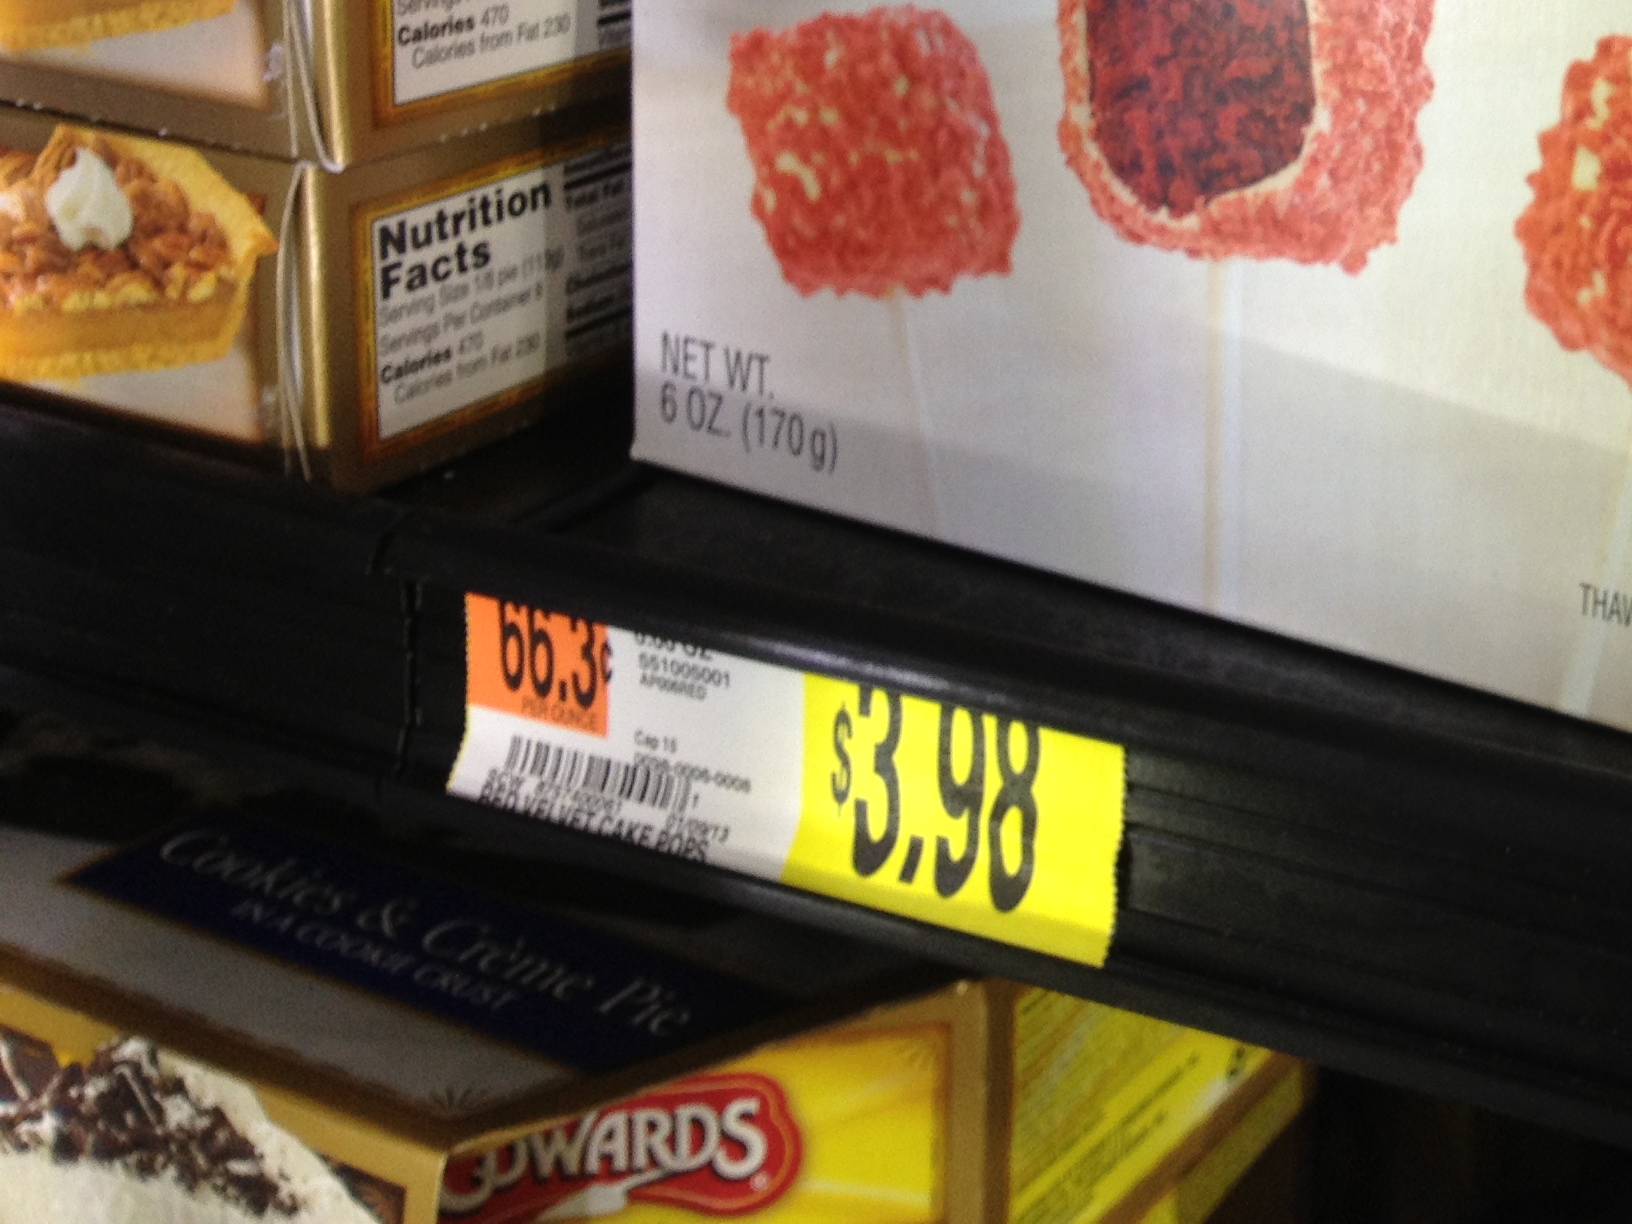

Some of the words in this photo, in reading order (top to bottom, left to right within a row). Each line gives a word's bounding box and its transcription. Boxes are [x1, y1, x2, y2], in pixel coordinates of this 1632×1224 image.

[398, 15, 475, 46] Calories
[378, 182, 552, 261] Nutrition
[381, 239, 492, 301] Facts
[382, 346, 453, 386] Calories
[660, 330, 716, 383] NET
[723, 344, 775, 400] WT.
[660, 379, 678, 425] 6
[158, 827, 358, 918] Cookies
[600, 974, 693, 1038] Pie
